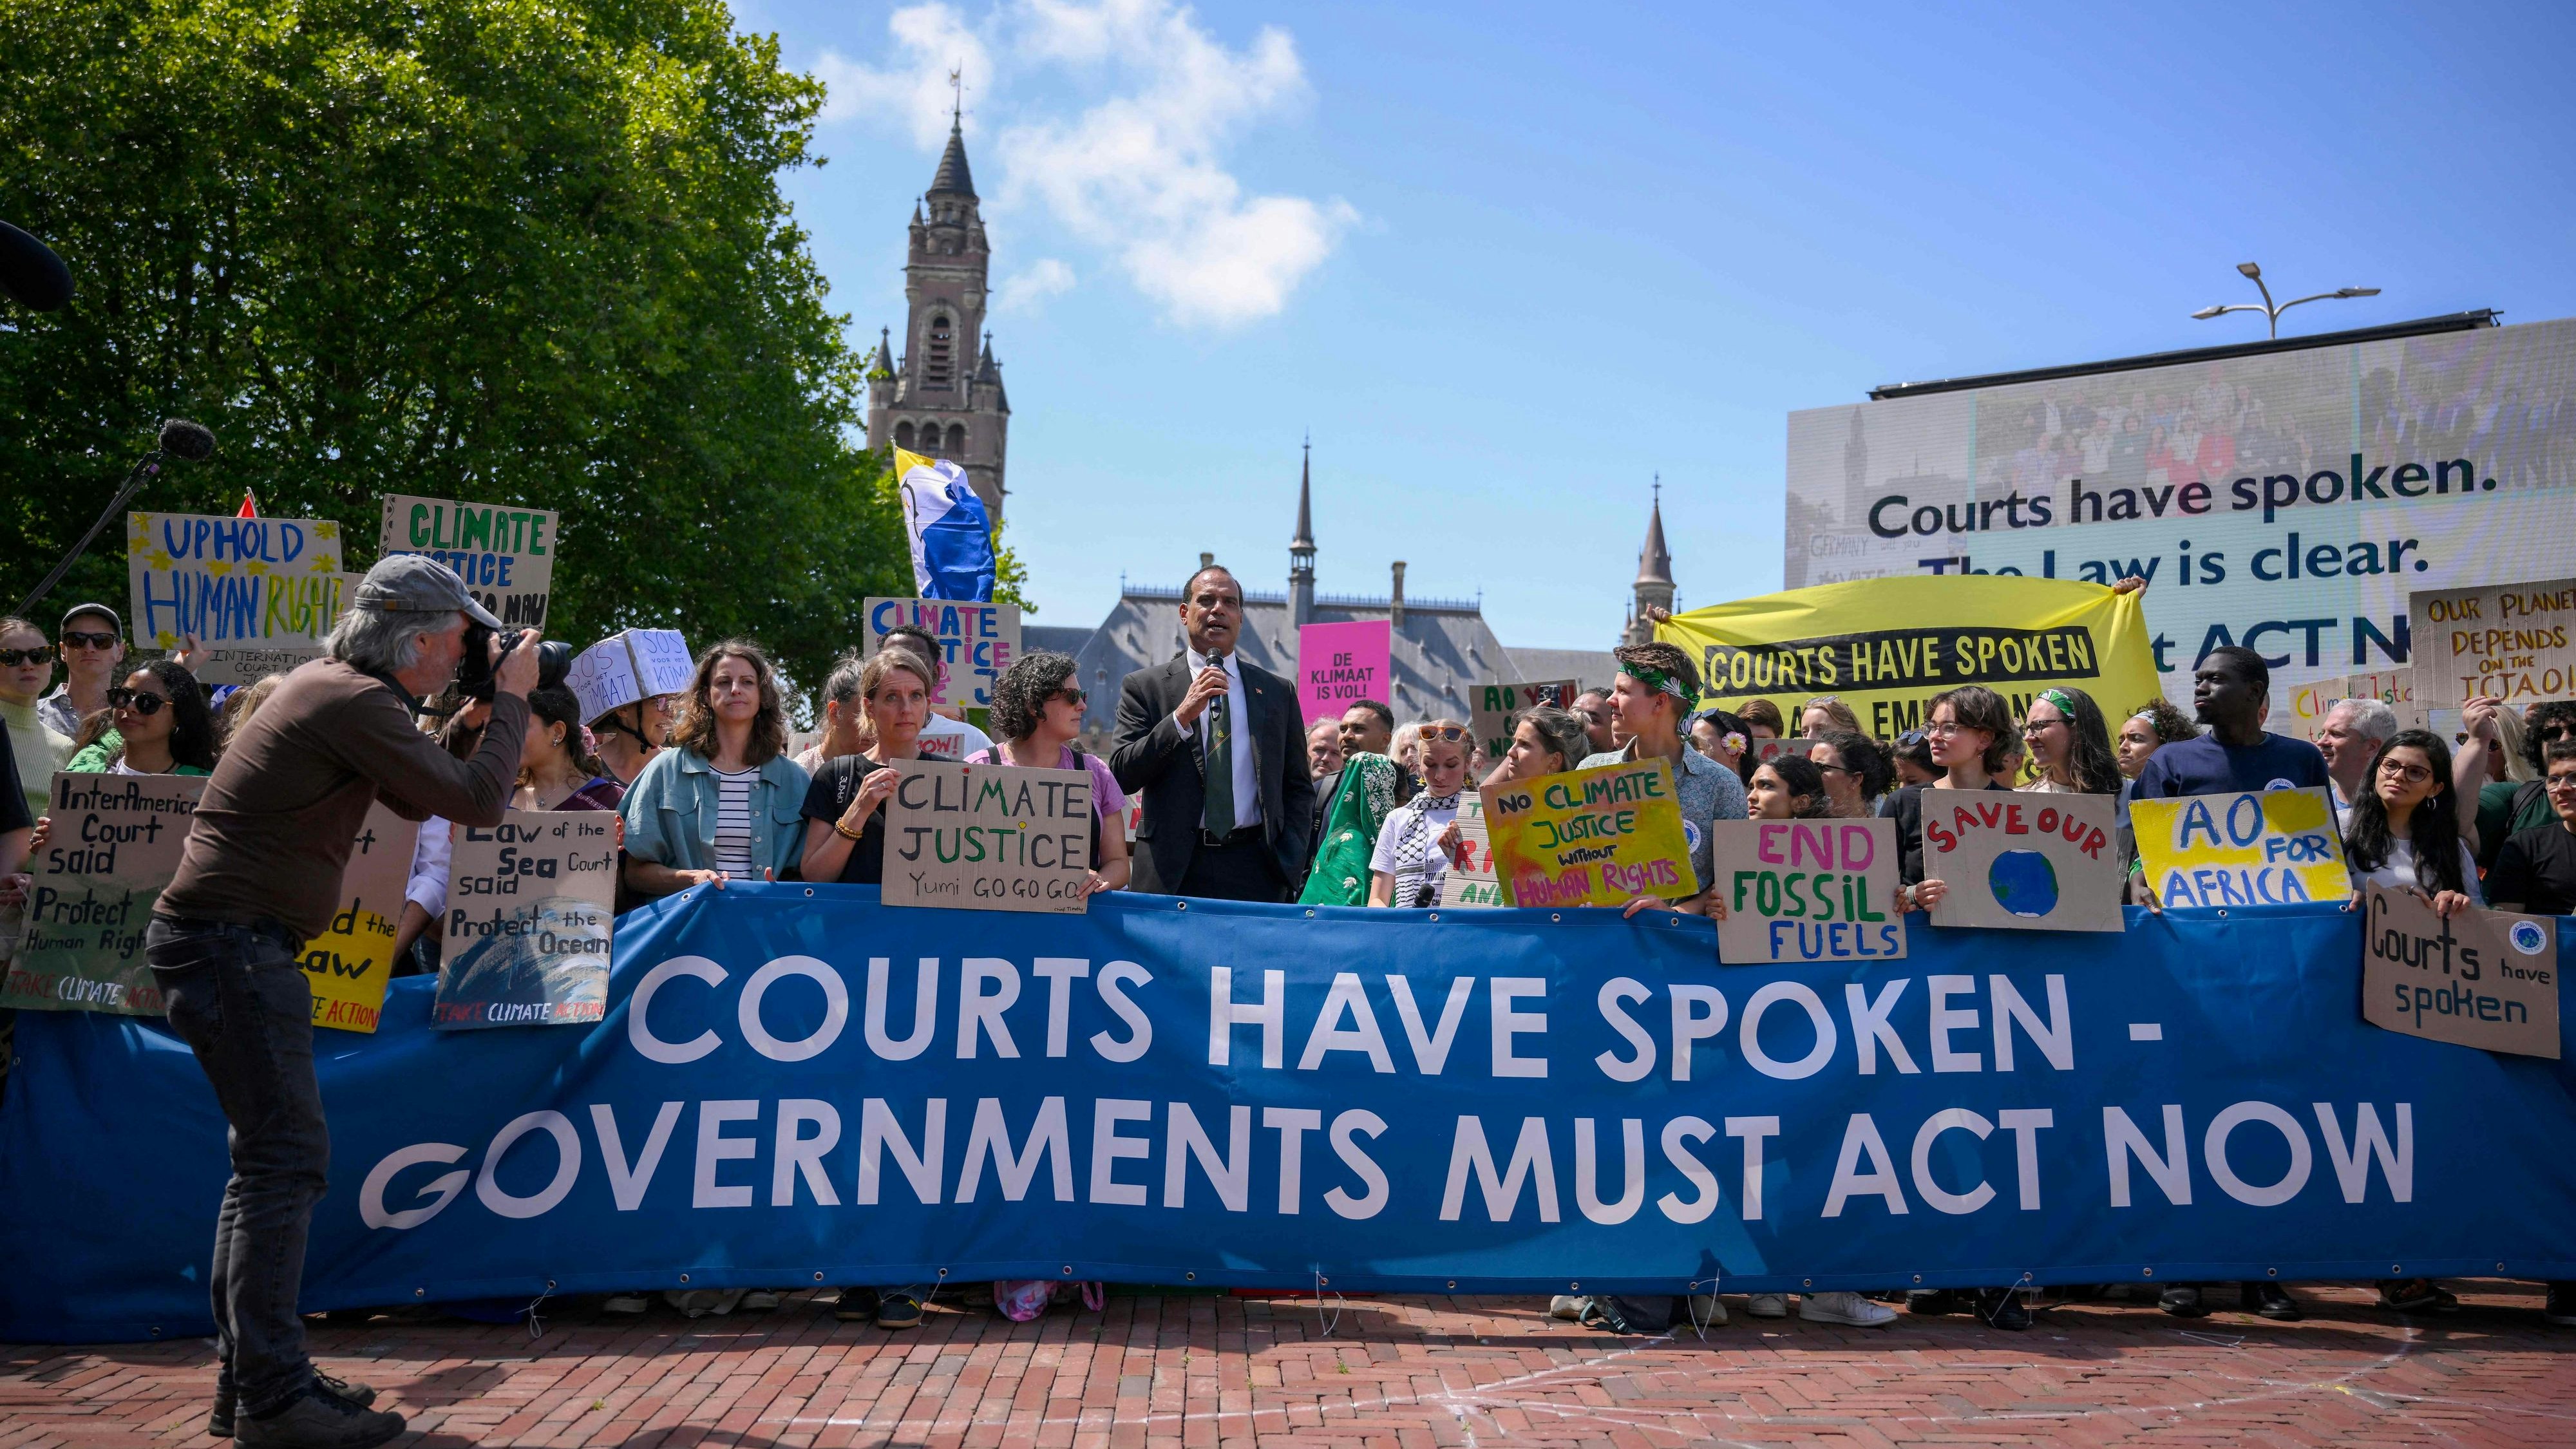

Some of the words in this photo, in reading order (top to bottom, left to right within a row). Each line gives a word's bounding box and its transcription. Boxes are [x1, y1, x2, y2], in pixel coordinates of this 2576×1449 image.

[1867, 488, 2052, 538] Courts
[2070, 480, 2211, 524] have
[2231, 453, 2497, 522] spoken.
[164, 518, 304, 564] UPHOLD
[2179, 540, 2226, 586] is
[2249, 531, 2429, 581] clear.
[144, 570, 260, 641] HUMAN
[264, 573, 344, 639] RIGHT
[2428, 597, 2481, 622] OUR
[644, 631, 683, 654] SOS
[2191, 618, 2338, 671] ACT
[2451, 625, 2568, 657] DEPENDS
[235, 663, 279, 673] COURT
[1333, 652, 1352, 667] DE
[1709, 643, 1837, 691] COURTS
[1851, 636, 1939, 682] HAVE
[1955, 634, 2091, 676] SPOKEN
[2479, 658, 2504, 674] ON
[2508, 655, 2535, 668] THE
[596, 672, 608, 681] HET
[1311, 667, 1374, 684] KLIMAAT
[1316, 687, 1331, 699] IS
[1336, 684, 1367, 699] VOL!
[1484, 685, 1515, 712] AO
[917, 735, 960, 755] OW!
[837, 775, 848, 803] DAKINE
[1498, 793, 1532, 815] NO
[1544, 772, 1665, 810] CLIMATE
[81, 813, 164, 844] Court
[552, 822, 569, 838] of
[578, 822, 605, 837] the
[1531, 810, 1635, 848] JUSTICE
[1927, 802, 2030, 853] SAVE
[2037, 807, 2107, 860] OUR
[2180, 793, 2264, 849] AO
[47, 842, 117, 875] said
[497, 847, 558, 878] Sea
[567, 852, 613, 871] Court
[1757, 824, 1875, 871] END
[2266, 835, 2331, 865] FOR
[459, 873, 519, 896] said
[909, 871, 960, 896] Yumi
[974, 878, 1006, 898] GO
[1012, 878, 1039, 898] GO
[1046, 878, 1078, 899] GO
[1512, 870, 1591, 907] HUMAN
[2163, 867, 2309, 907] AFRICA
[32, 886, 133, 927] Protect
[449, 904, 542, 938] Protect
[563, 911, 598, 927] the
[25, 928, 85, 951] Human
[366, 913, 395, 937] the
[1769, 920, 1899, 960] FUELS
[2371, 893, 2481, 981] Courts
[2501, 958, 2551, 985] have
[538, 932, 610, 955] Ocean
[58, 975, 124, 1006] CLIMATE
[2394, 980, 2527, 1029] spoken
[326, 999, 381, 1030] ACTION
[437, 1001, 488, 1022] TAKE
[487, 1002, 551, 1022] CLIMATE
[554, 1001, 605, 1019] ACTION
[627, 955, 1154, 1065] COURTS
[1208, 965, 1549, 1078] HAVE
[1594, 974, 2075, 1082] SPOKEN
[358, 1095, 1390, 1231] GOVERNMENTS
[1439, 1112, 1781, 1225] MUST
[1820, 1106, 2054, 1220] ACT
[2107, 1099, 2414, 1209] NOW
